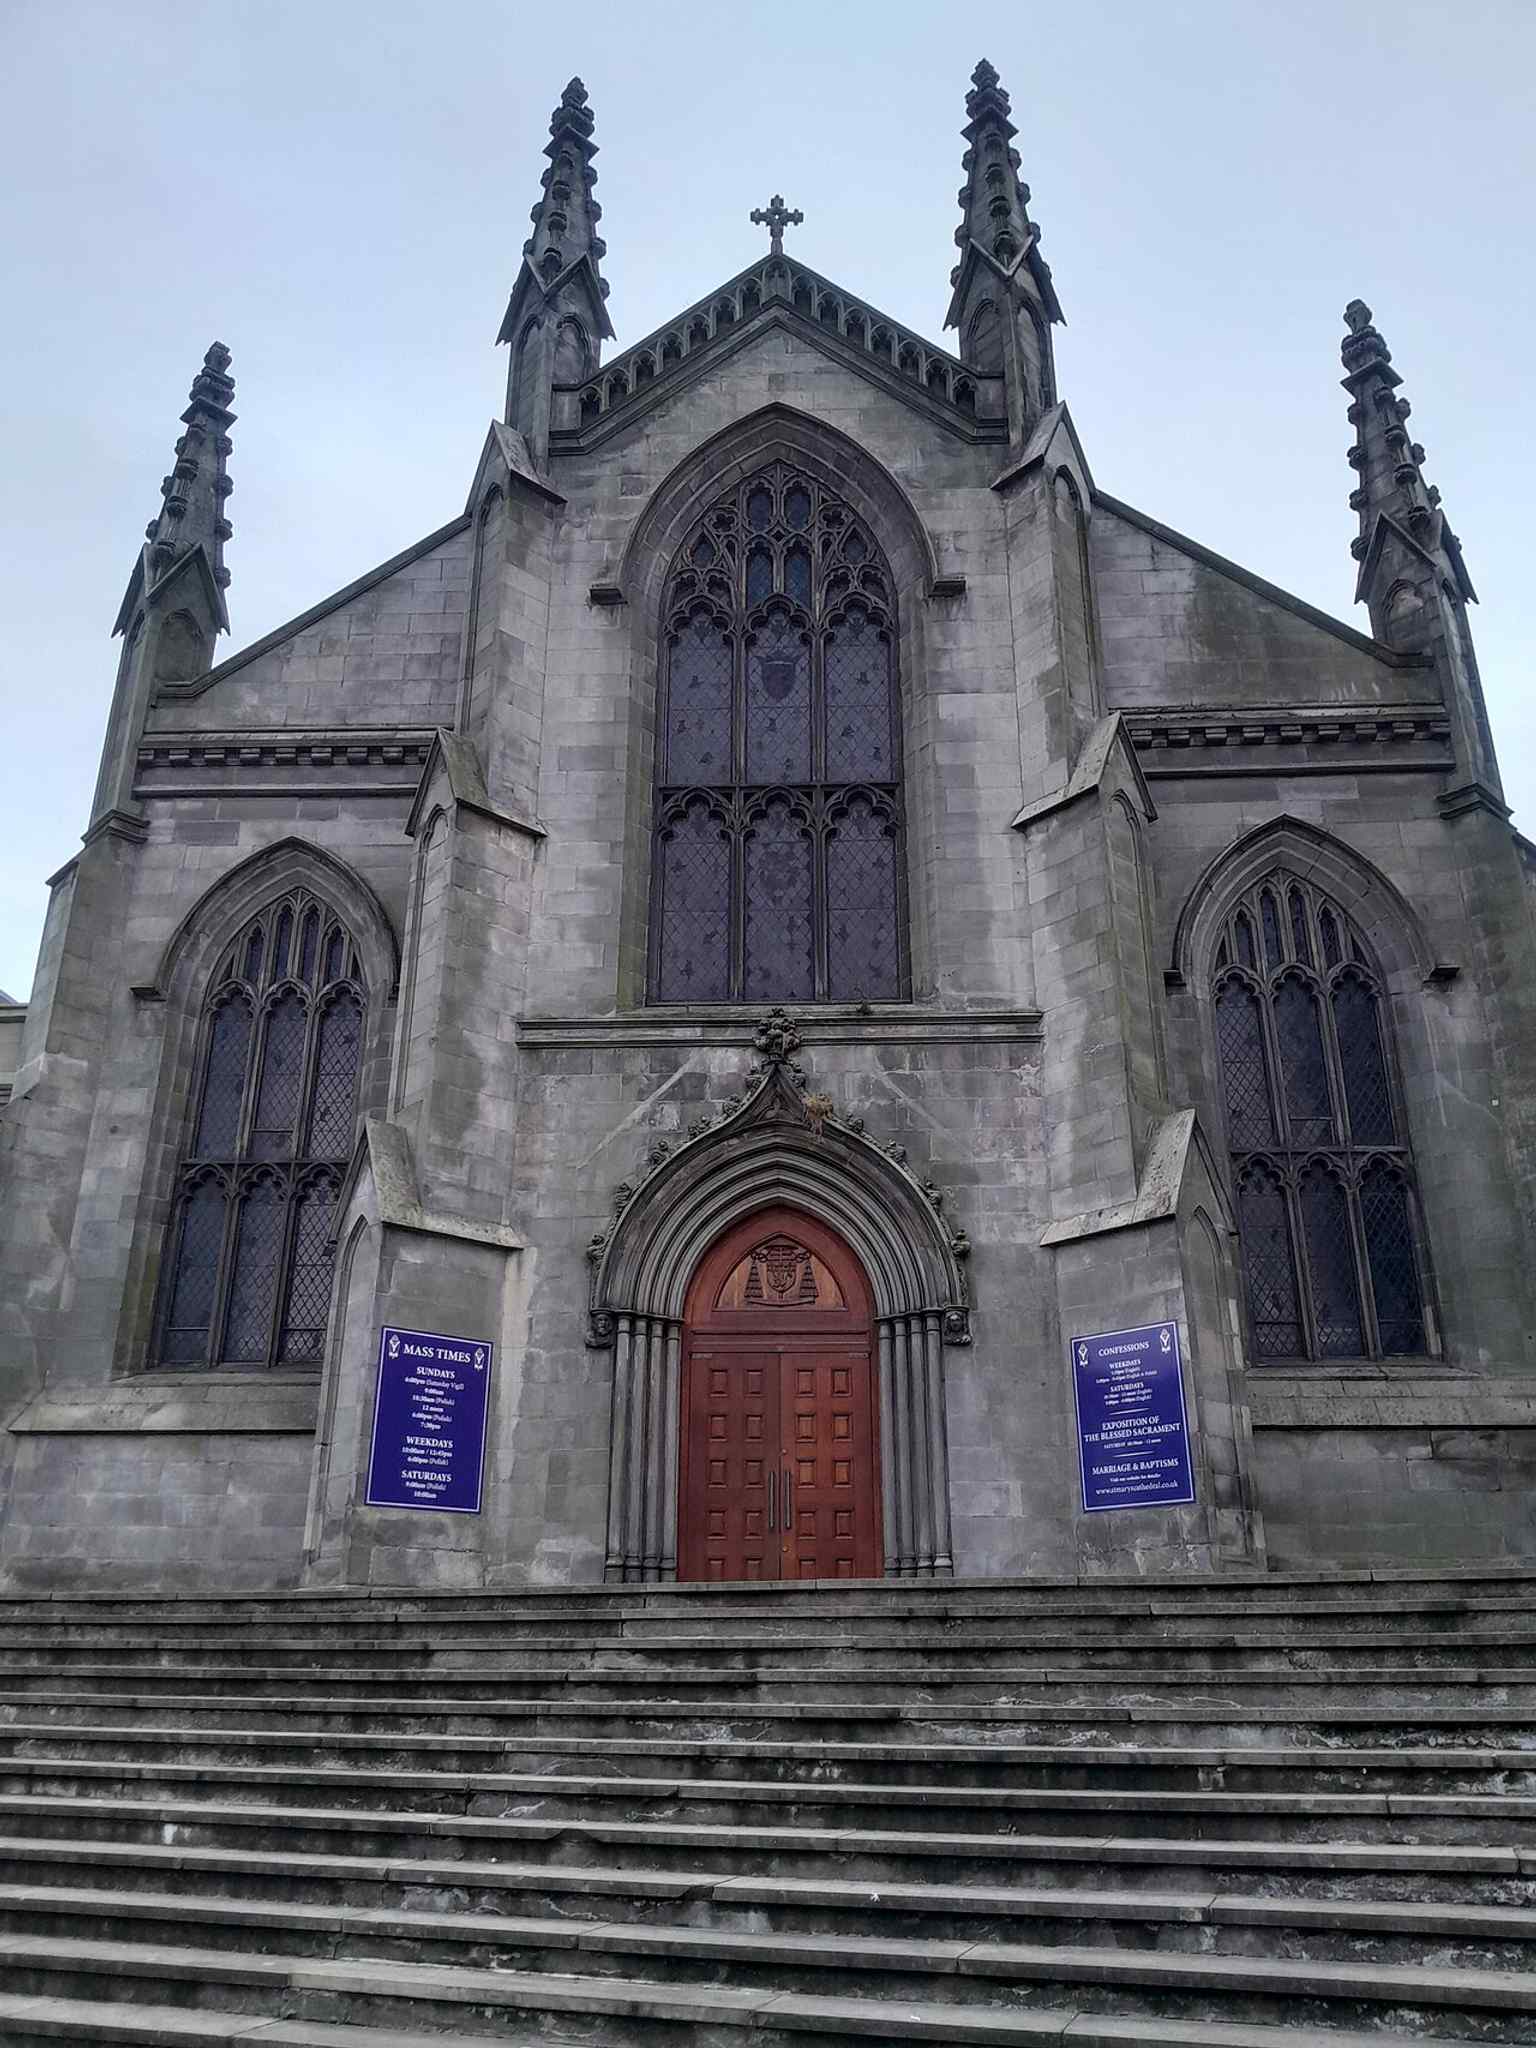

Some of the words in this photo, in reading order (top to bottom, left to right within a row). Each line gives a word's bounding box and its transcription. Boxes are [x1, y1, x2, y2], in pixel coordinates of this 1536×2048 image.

[404, 1344, 434, 1358] MASS
[436, 1347, 471, 1363] TIMES
[1098, 1341, 1149, 1356] CONFESSIONS
[1109, 1359, 1141, 1369] WEEKDAYS
[416, 1366, 456, 1379] SUNDAYS
[1110, 1381, 1144, 1392] SATURDAYS
[1102, 1416, 1147, 1430] EXPOSITION
[1148, 1415, 1160, 1424] OF
[1084, 1432, 1100, 1442] THE
[1101, 1428, 1132, 1440] BLESSED
[1133, 1423, 1181, 1436] SACRAMENT
[406, 1435, 453, 1448] WEEKDAYS
[1092, 1463, 1132, 1475] MARRIAGE
[1140, 1458, 1179, 1470] BAPTISMS
[401, 1469, 452, 1482] SATURDAYS
